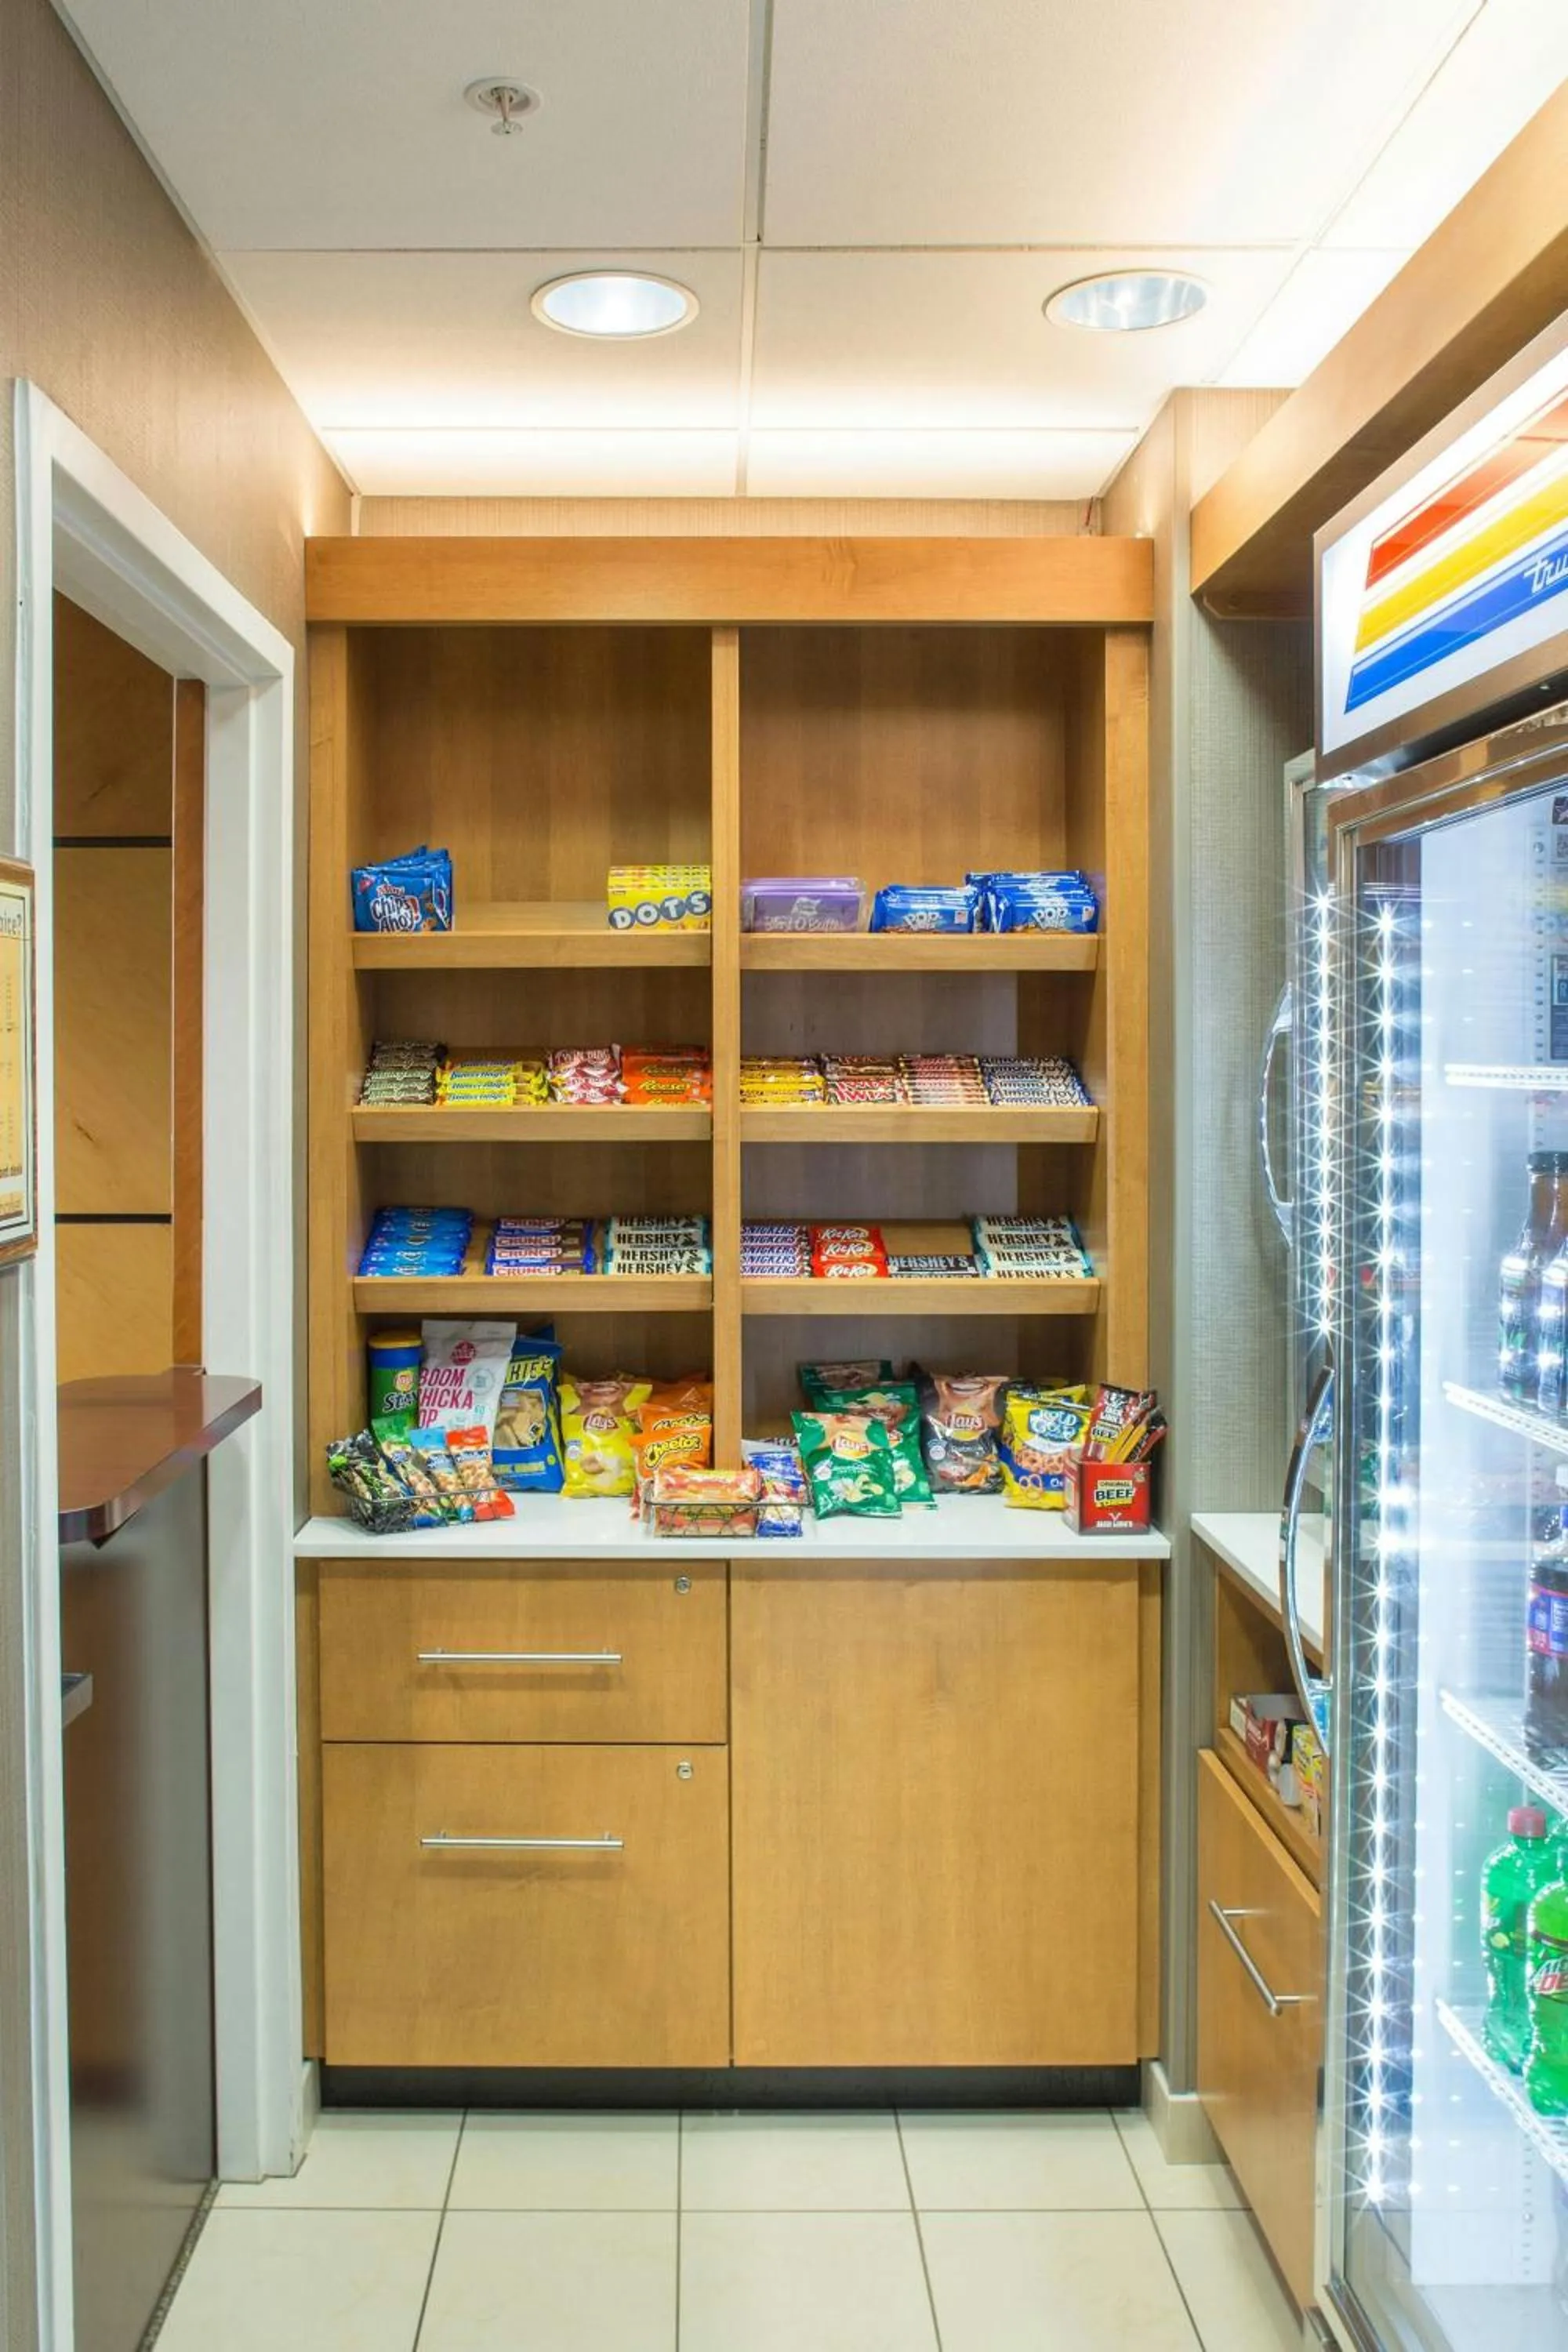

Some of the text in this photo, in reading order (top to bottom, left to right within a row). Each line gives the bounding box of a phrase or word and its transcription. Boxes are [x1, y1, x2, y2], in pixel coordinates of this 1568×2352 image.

[1523, 552, 1568, 593] tru
[372, 896, 411, 920] Chips
[613, 892, 707, 929] DOTS
[419, 1368, 465, 1387] BOOM
[419, 1409, 438, 1428] OP
[1095, 1489, 1134, 1501] BEEF
